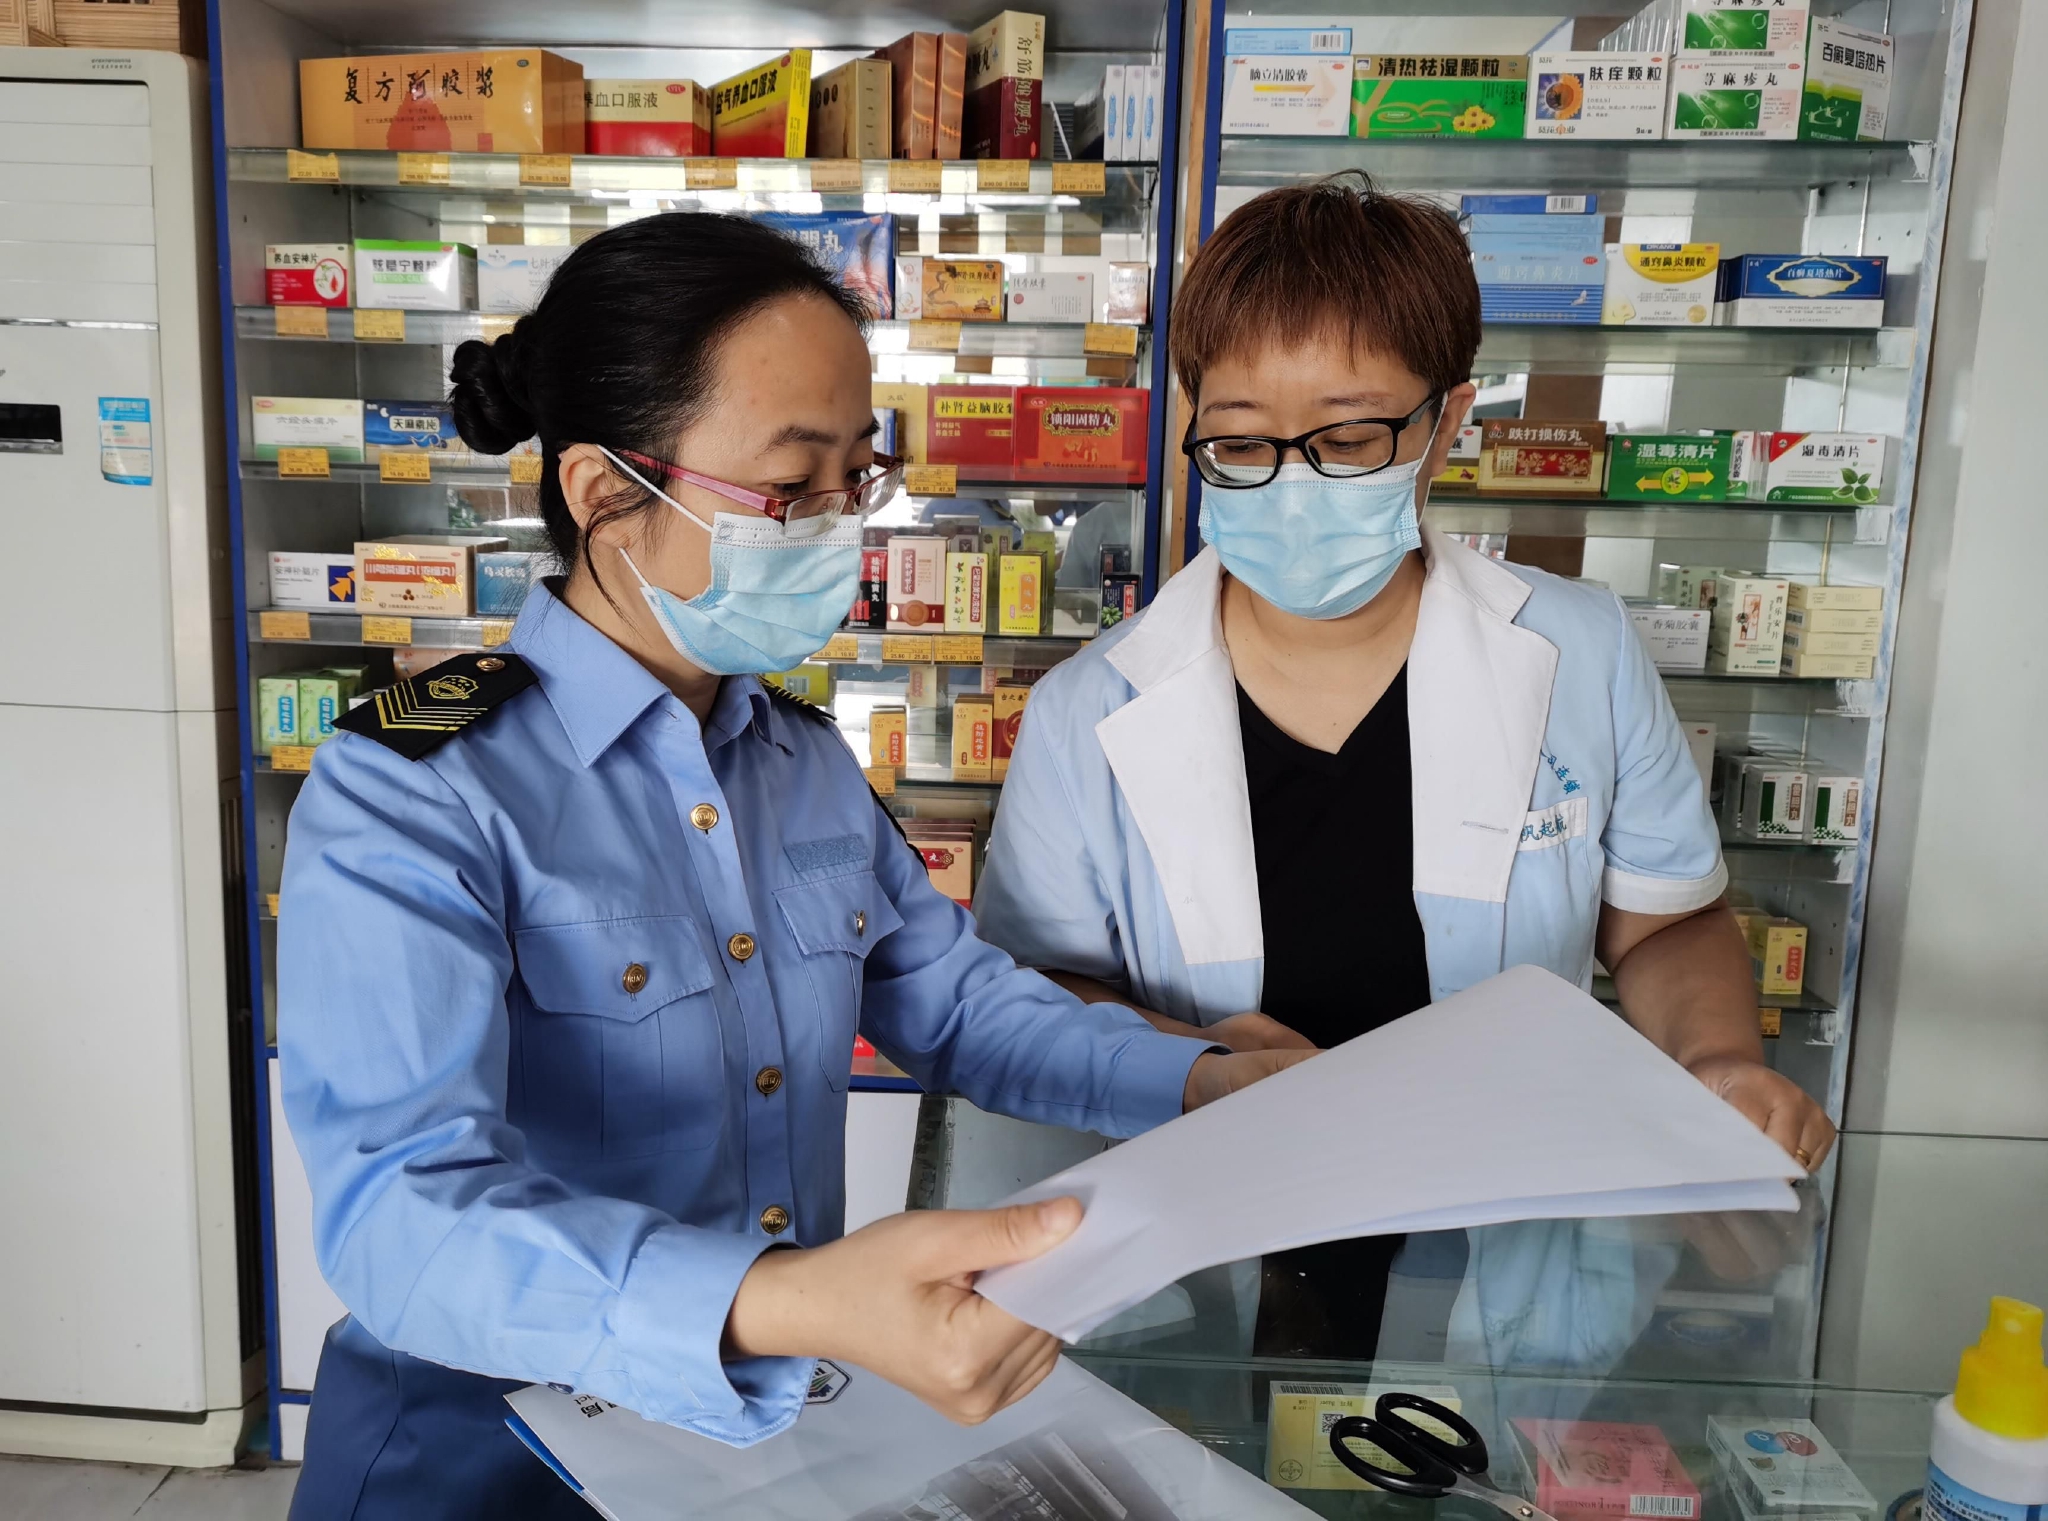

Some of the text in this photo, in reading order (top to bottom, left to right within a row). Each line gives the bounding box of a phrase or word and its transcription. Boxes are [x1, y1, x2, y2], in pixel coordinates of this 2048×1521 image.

[1822, 42, 1886, 74] 百癣夏塔热片
[1378, 57, 1500, 77] 清热祛湿颗粒
[1588, 66, 1662, 81] 肤痒颗粒
[715, 68, 778, 115] 益气养血口服液
[1640, 256, 1706, 267] 通窍鼻炎颗粒
[1508, 427, 1583, 443] 跌打损伤丸
[1637, 443, 1717, 459] 湿毒清片
[1802, 445, 1861, 458] 湿毒清片
[1652, 619, 1699, 631] 香菊胶囊
